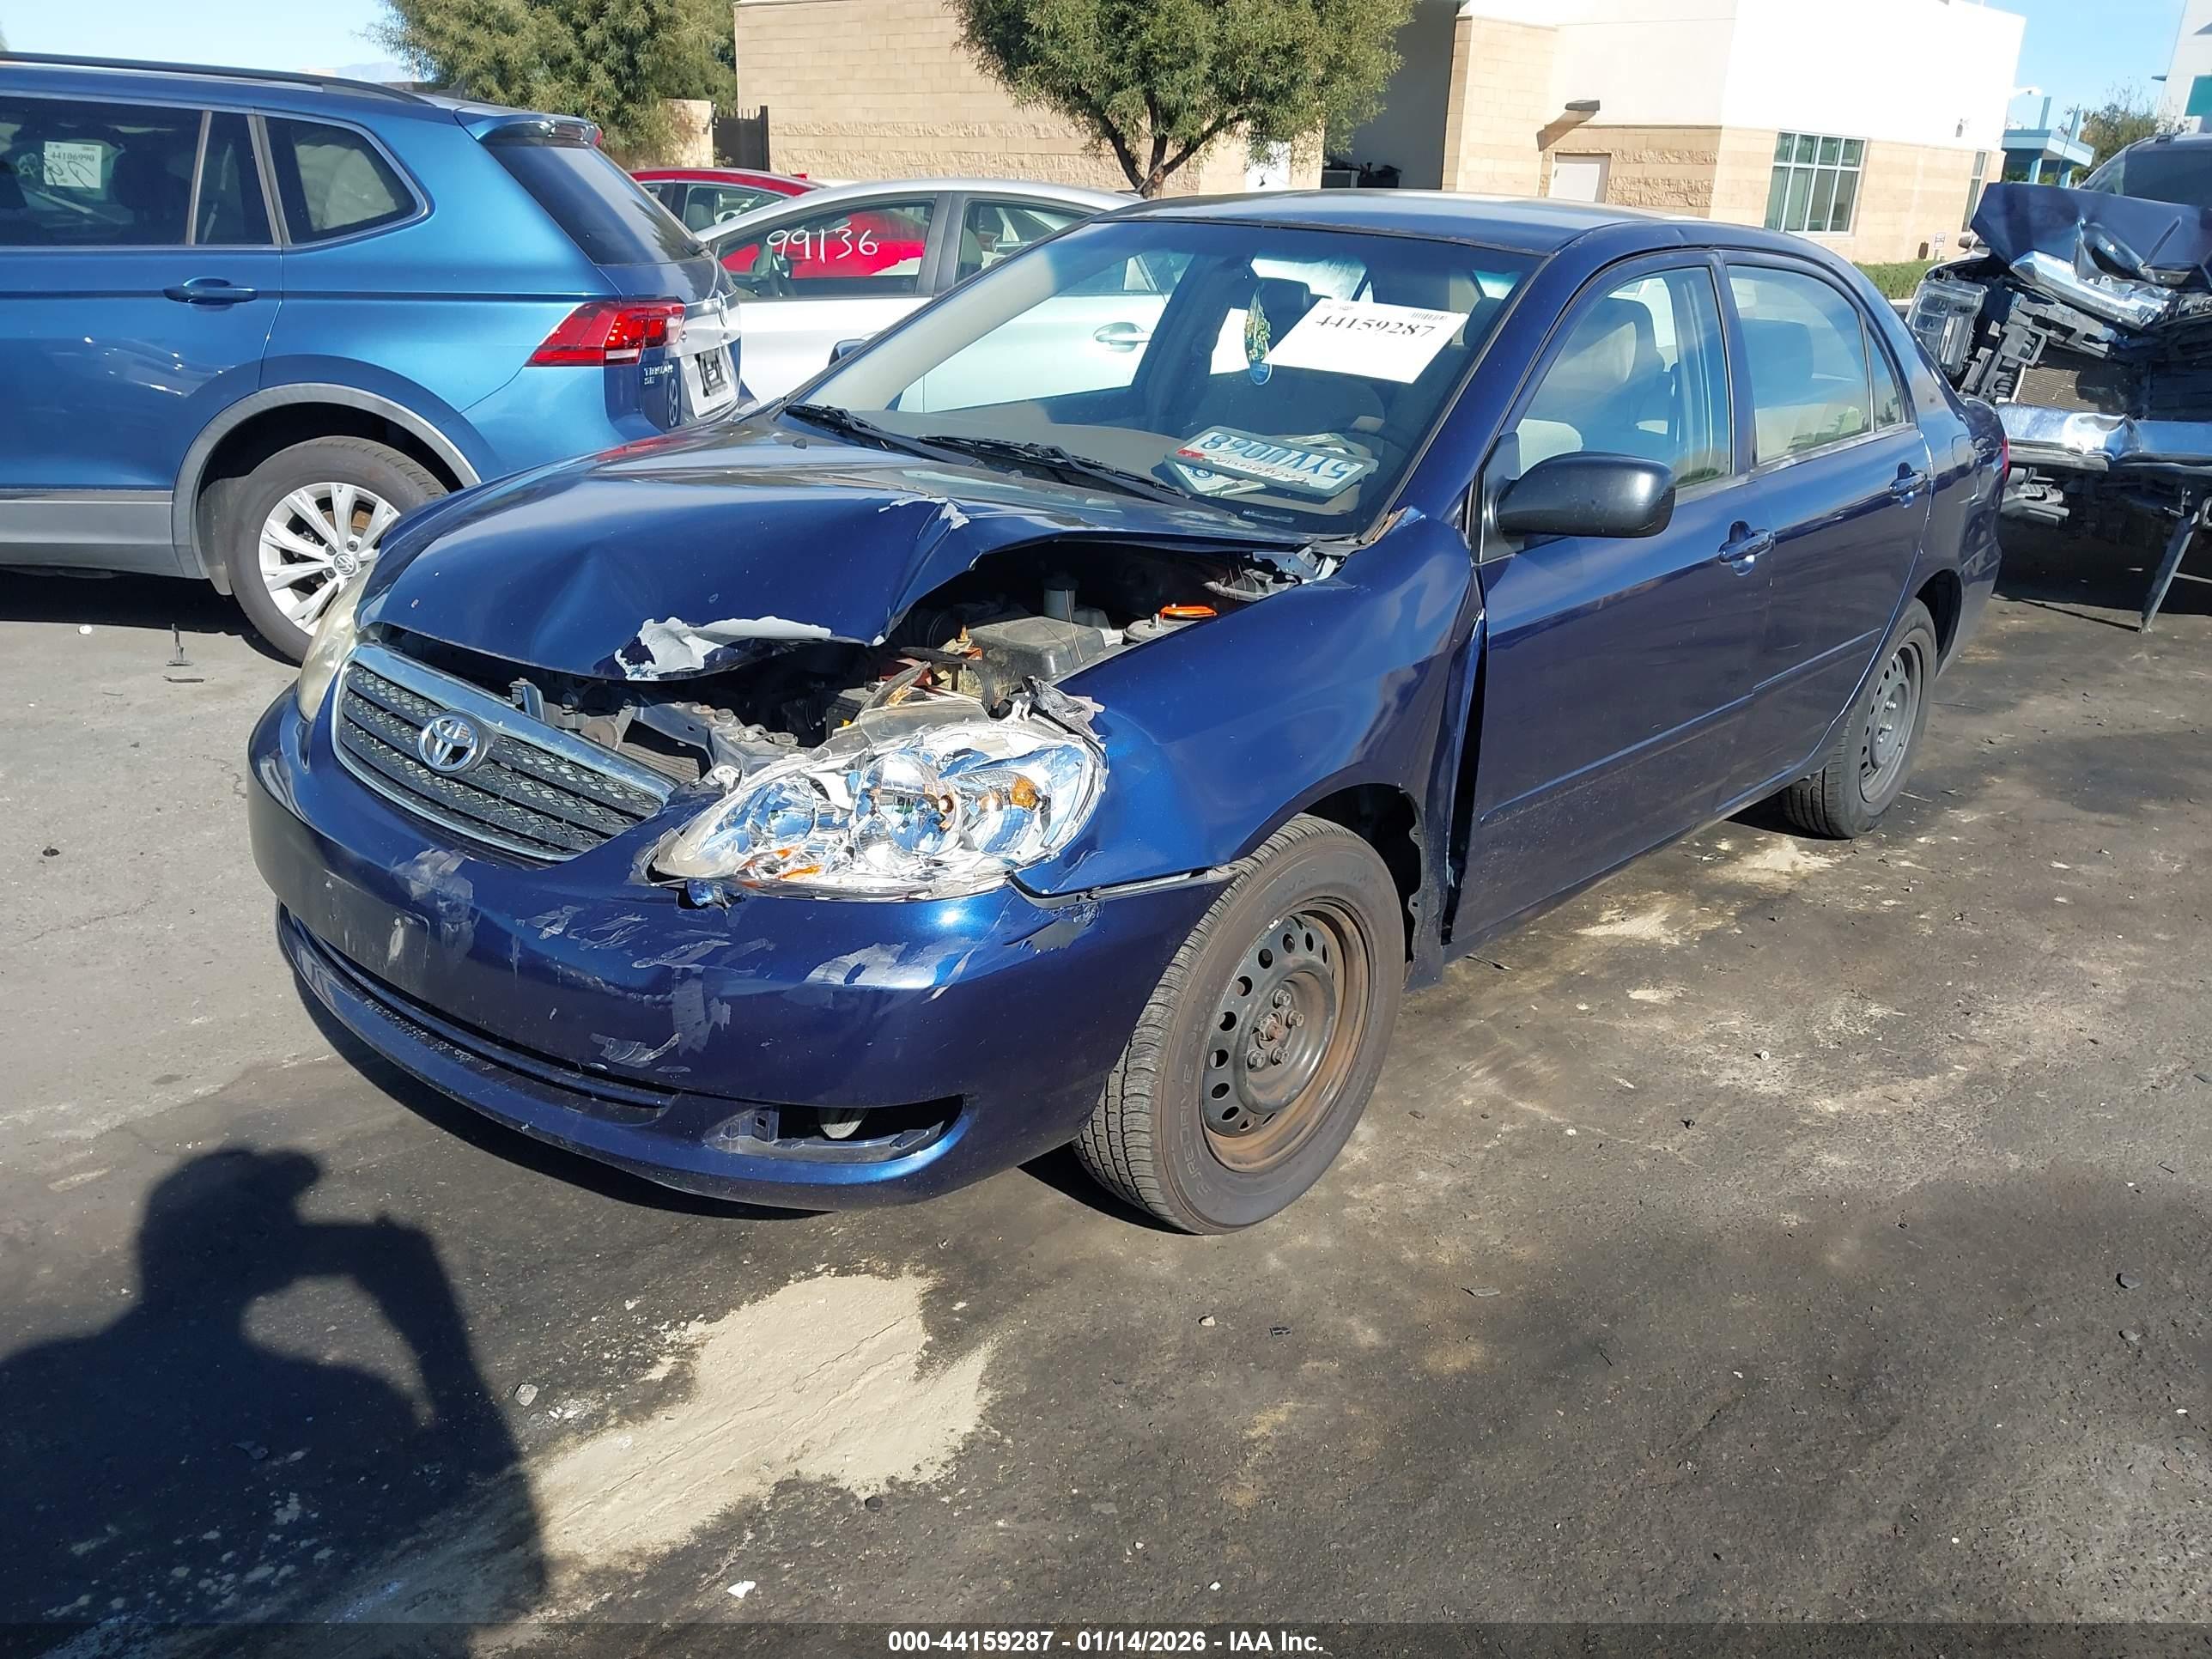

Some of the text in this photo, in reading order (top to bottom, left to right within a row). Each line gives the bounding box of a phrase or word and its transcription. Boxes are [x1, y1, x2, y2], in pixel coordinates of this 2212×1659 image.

[50, 151, 95, 162] 44106990
[766, 228, 880, 264] 99136
[1316, 314, 1437, 337] 44159287
